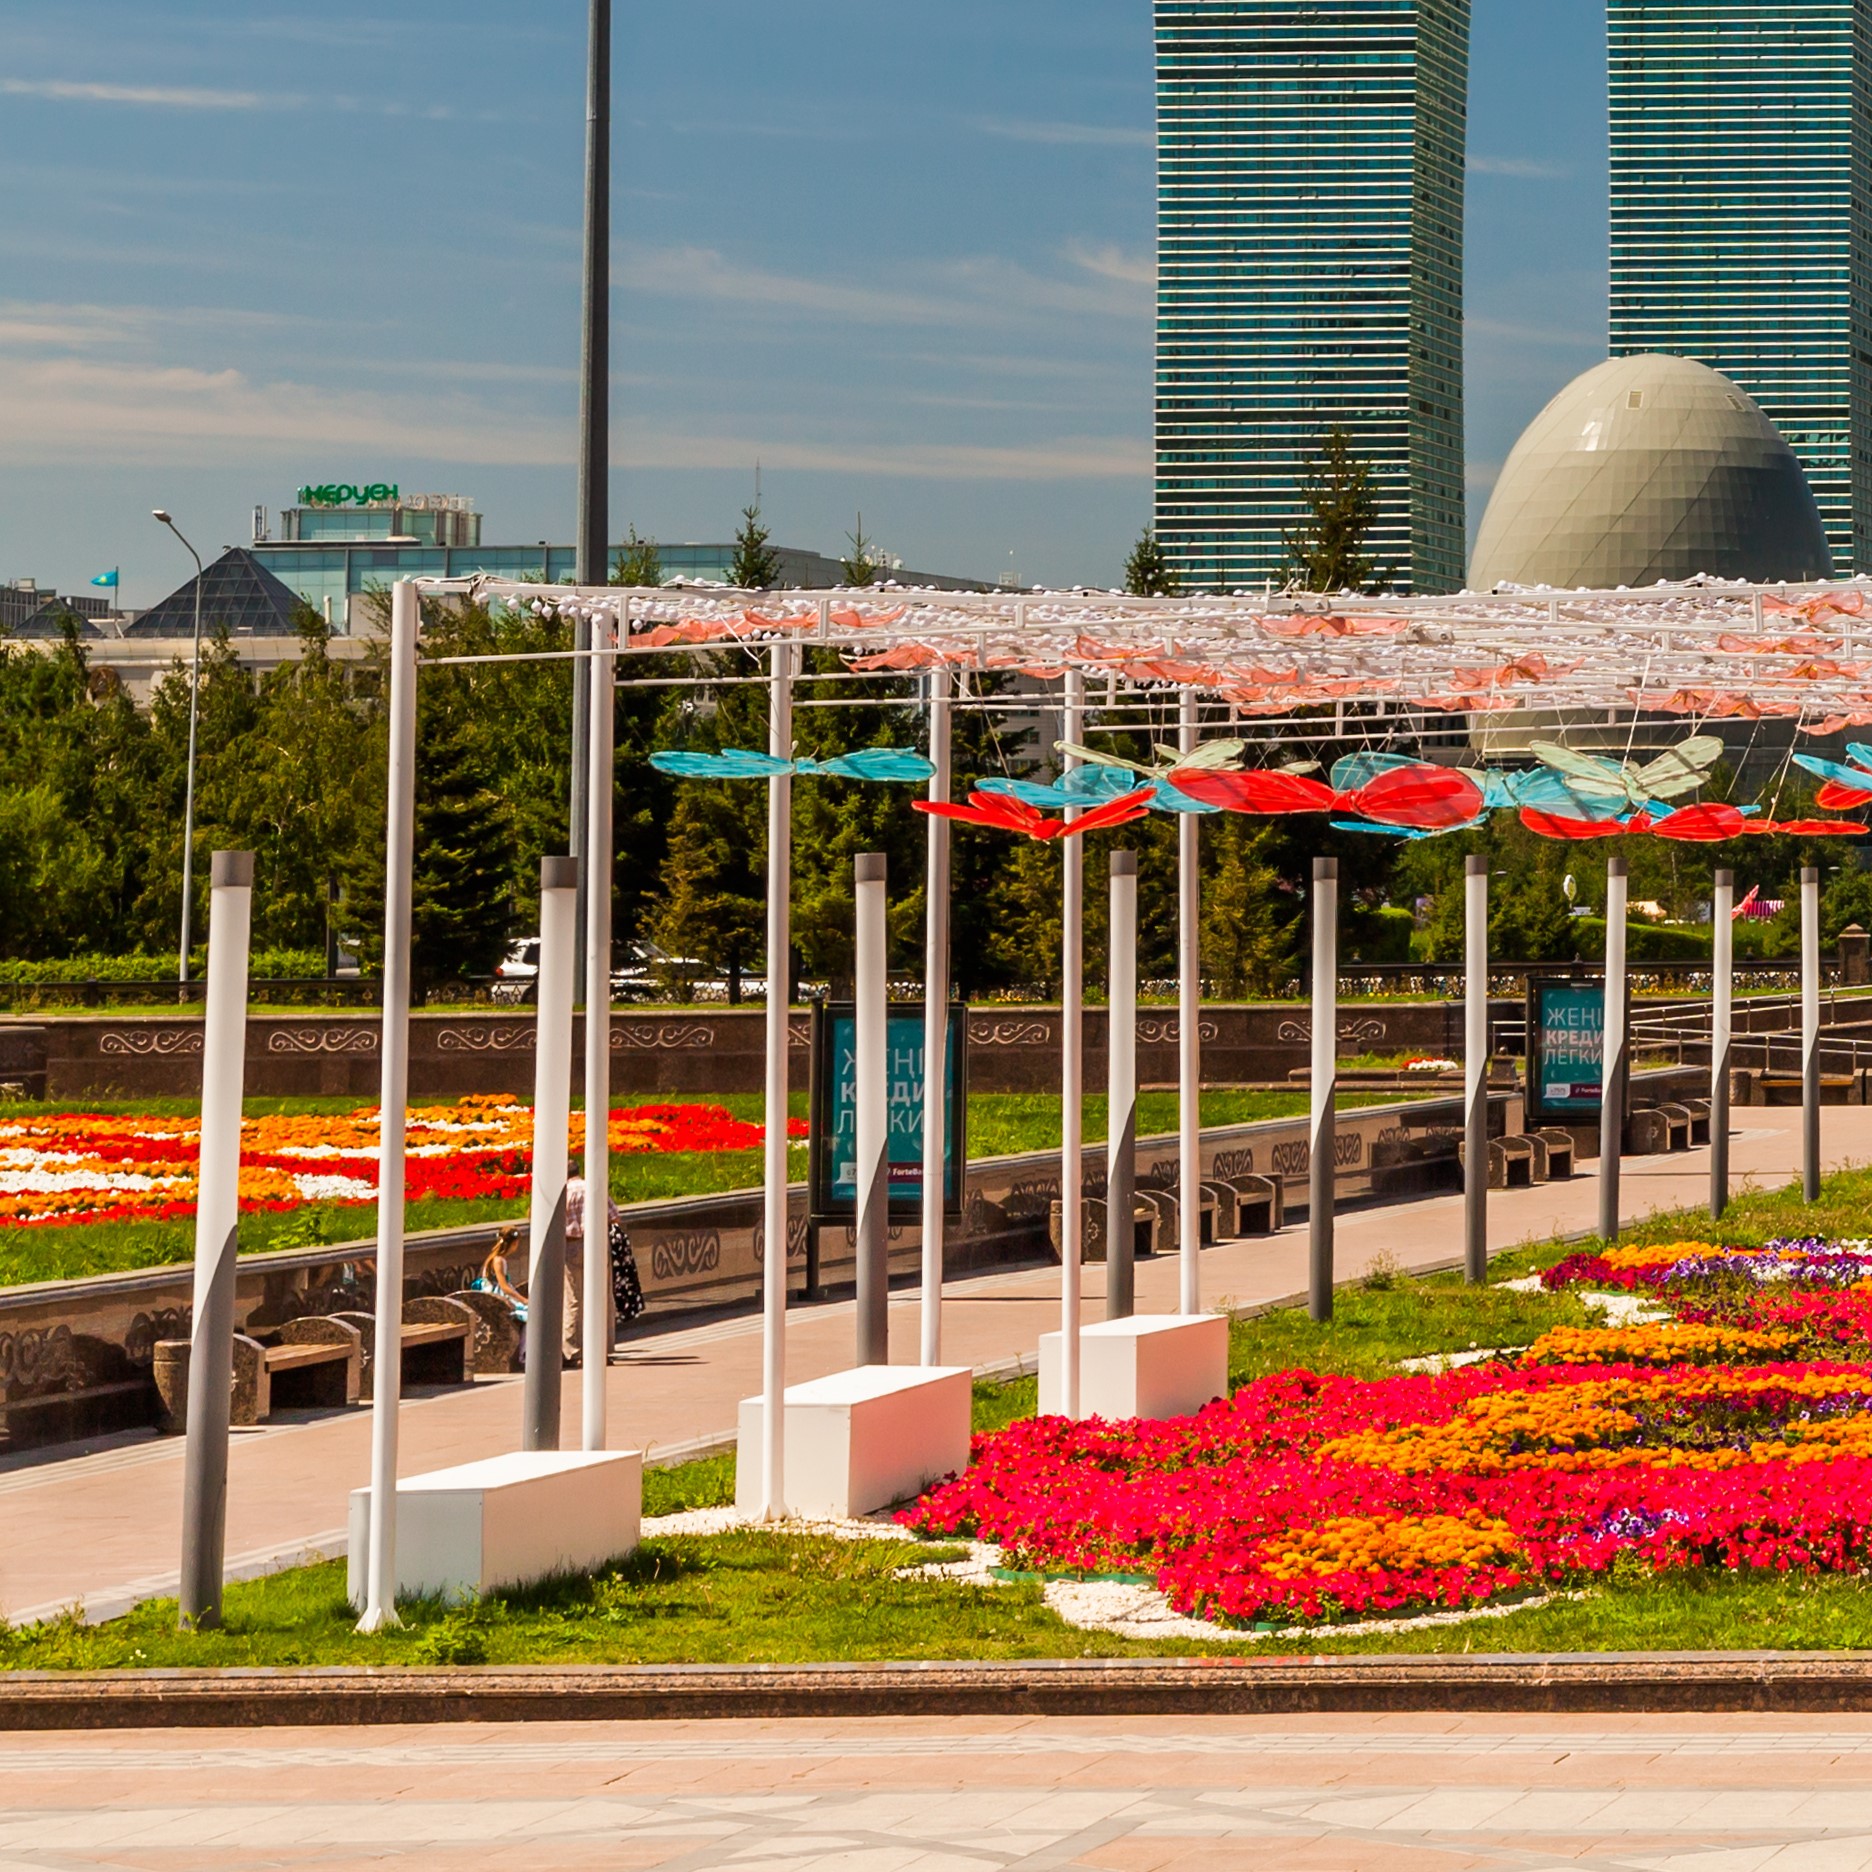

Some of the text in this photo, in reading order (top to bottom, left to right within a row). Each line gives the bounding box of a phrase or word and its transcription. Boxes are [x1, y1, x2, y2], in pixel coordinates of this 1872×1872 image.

[1546, 1007, 1601, 1029] ЖЕҢІ
[1546, 1030, 1604, 1047] КРЕДИ
[1544, 1046, 1603, 1065] ЛЁГКИ
[892, 1167, 923, 1176] ForteBa
